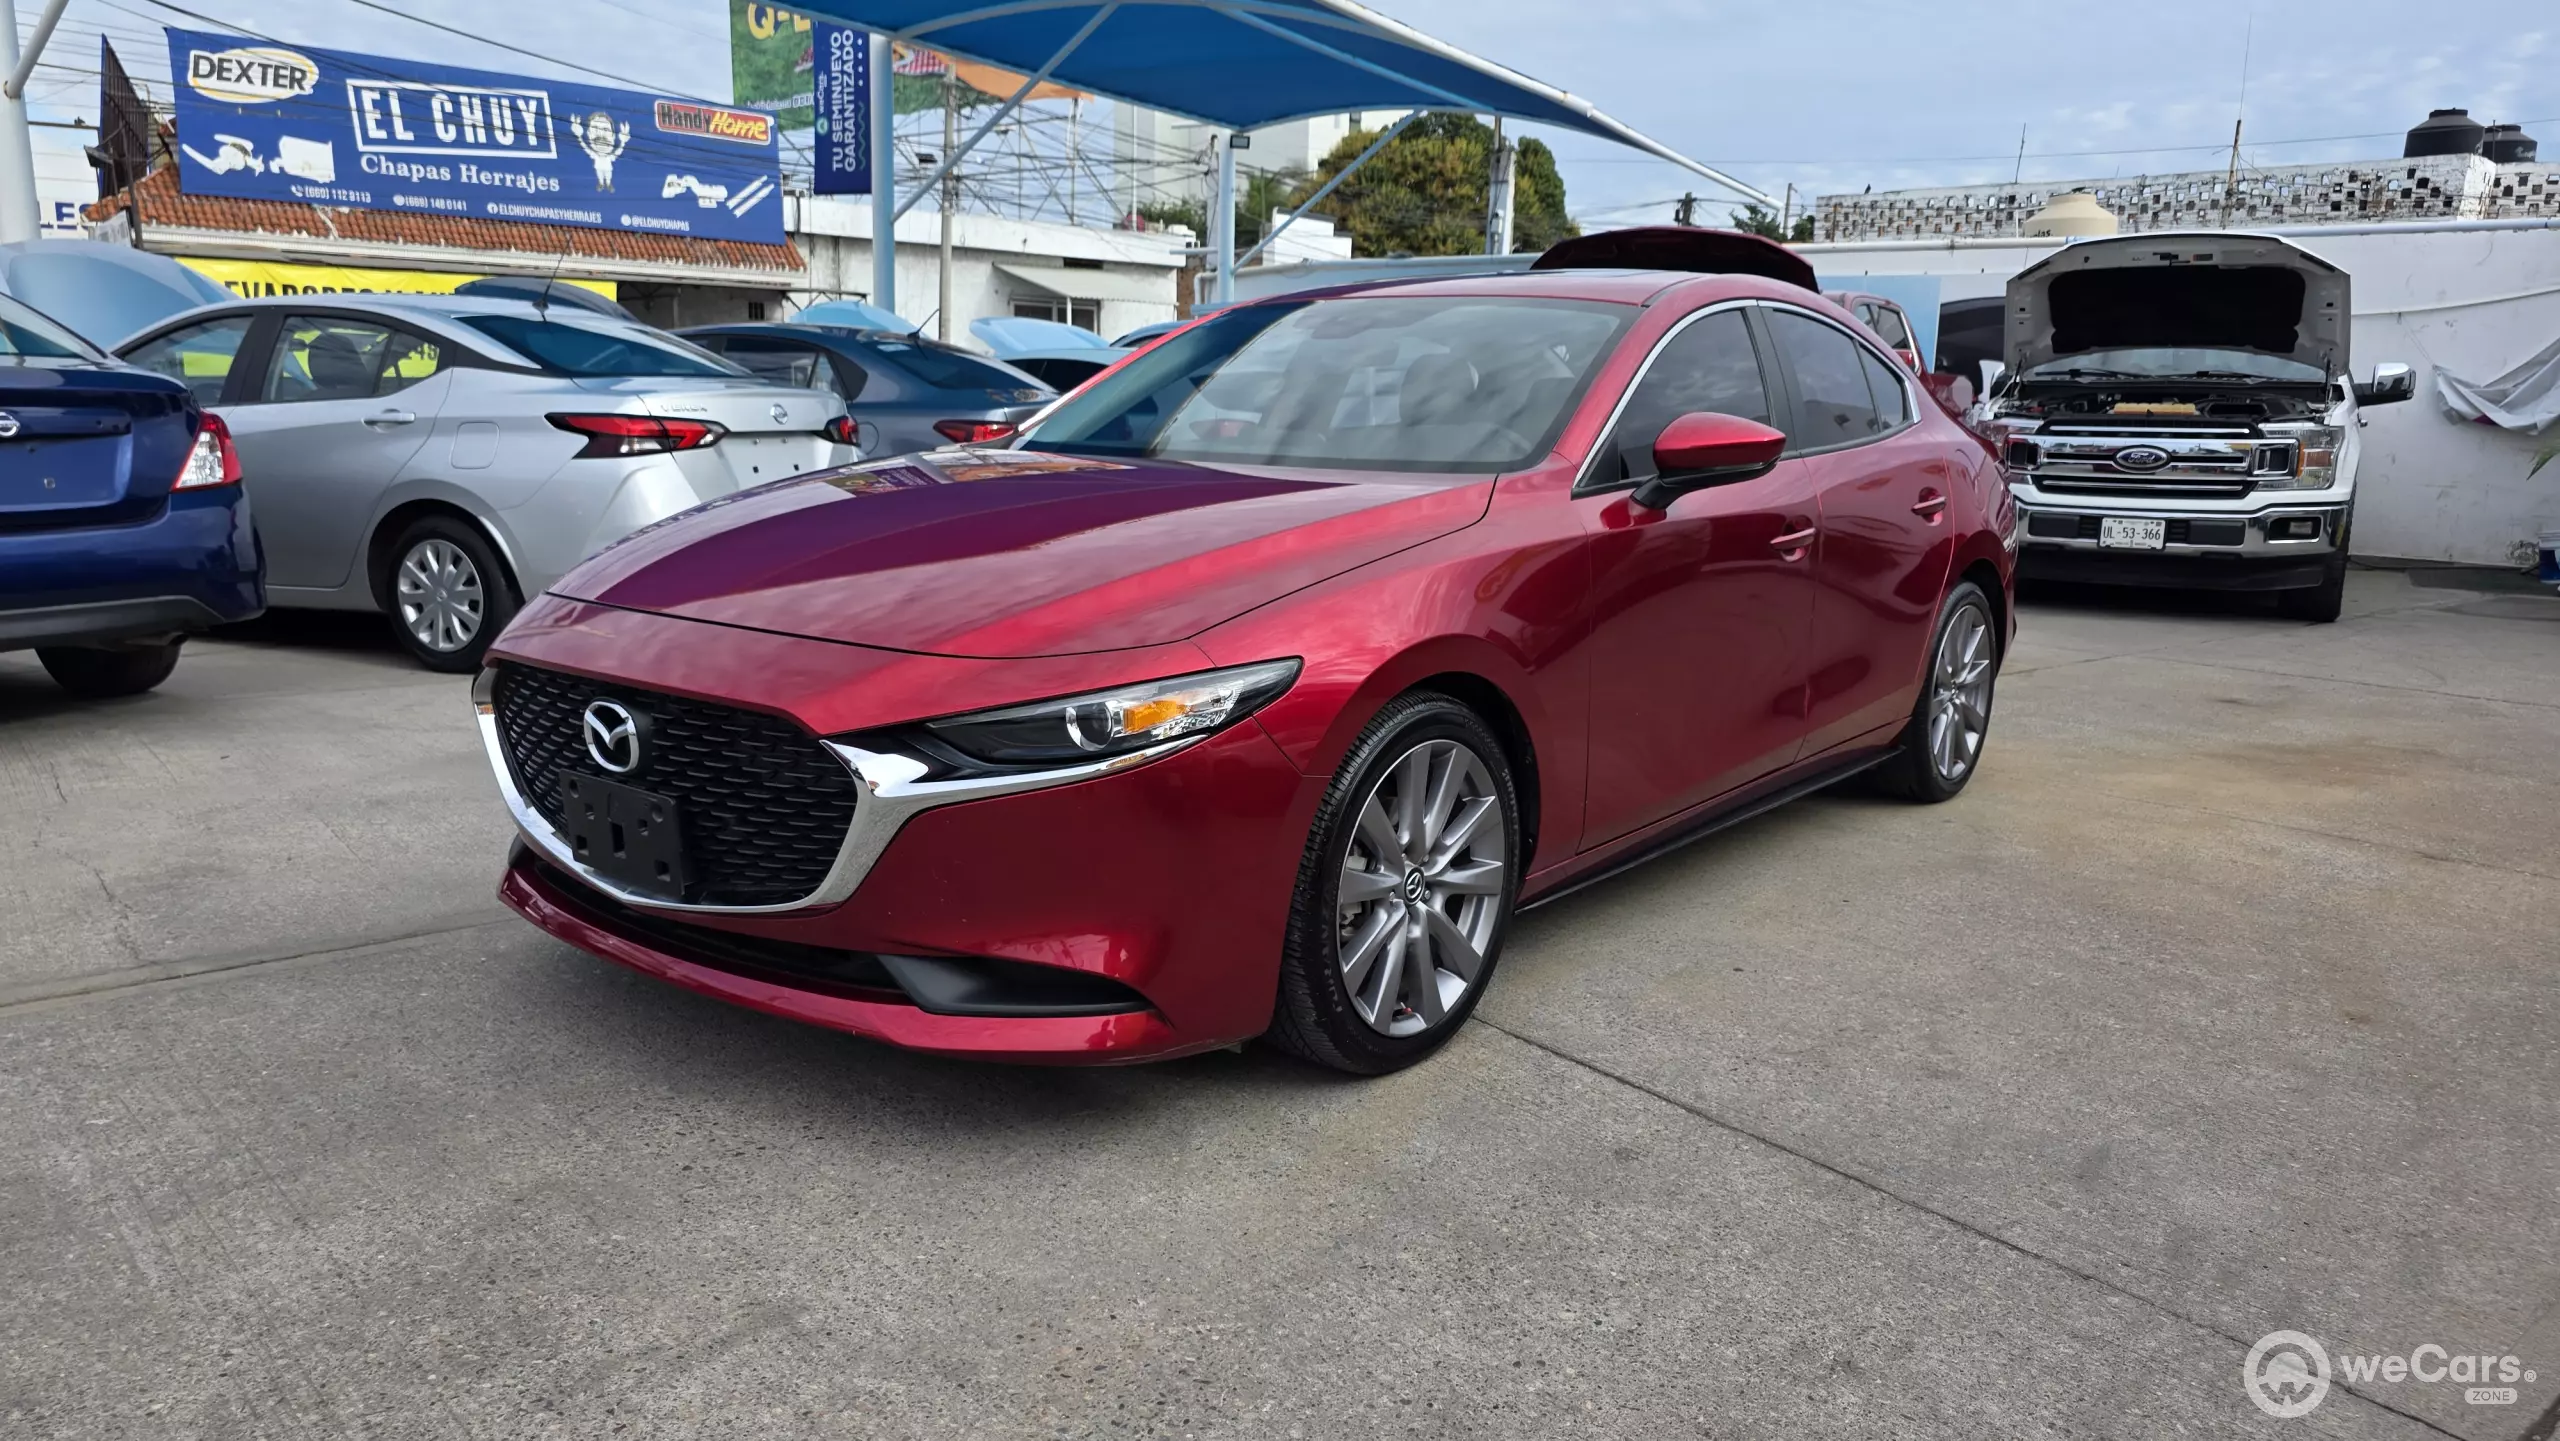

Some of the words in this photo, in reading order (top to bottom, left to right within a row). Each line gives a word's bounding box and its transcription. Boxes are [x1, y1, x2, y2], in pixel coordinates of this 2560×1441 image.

[192, 54, 308, 91] DEXTER
[831, 32, 843, 142] SEMINUEVO
[361, 88, 415, 140] EL
[432, 93, 538, 146] CHUY
[842, 29, 856, 172] GARANTIZADO
[360, 154, 451, 182] Chapas
[459, 163, 560, 193] Herrajes
[832, 147, 843, 172] TU
[2128, 451, 2156, 464] Ford
[2103, 526, 2160, 540] UL-53-366
